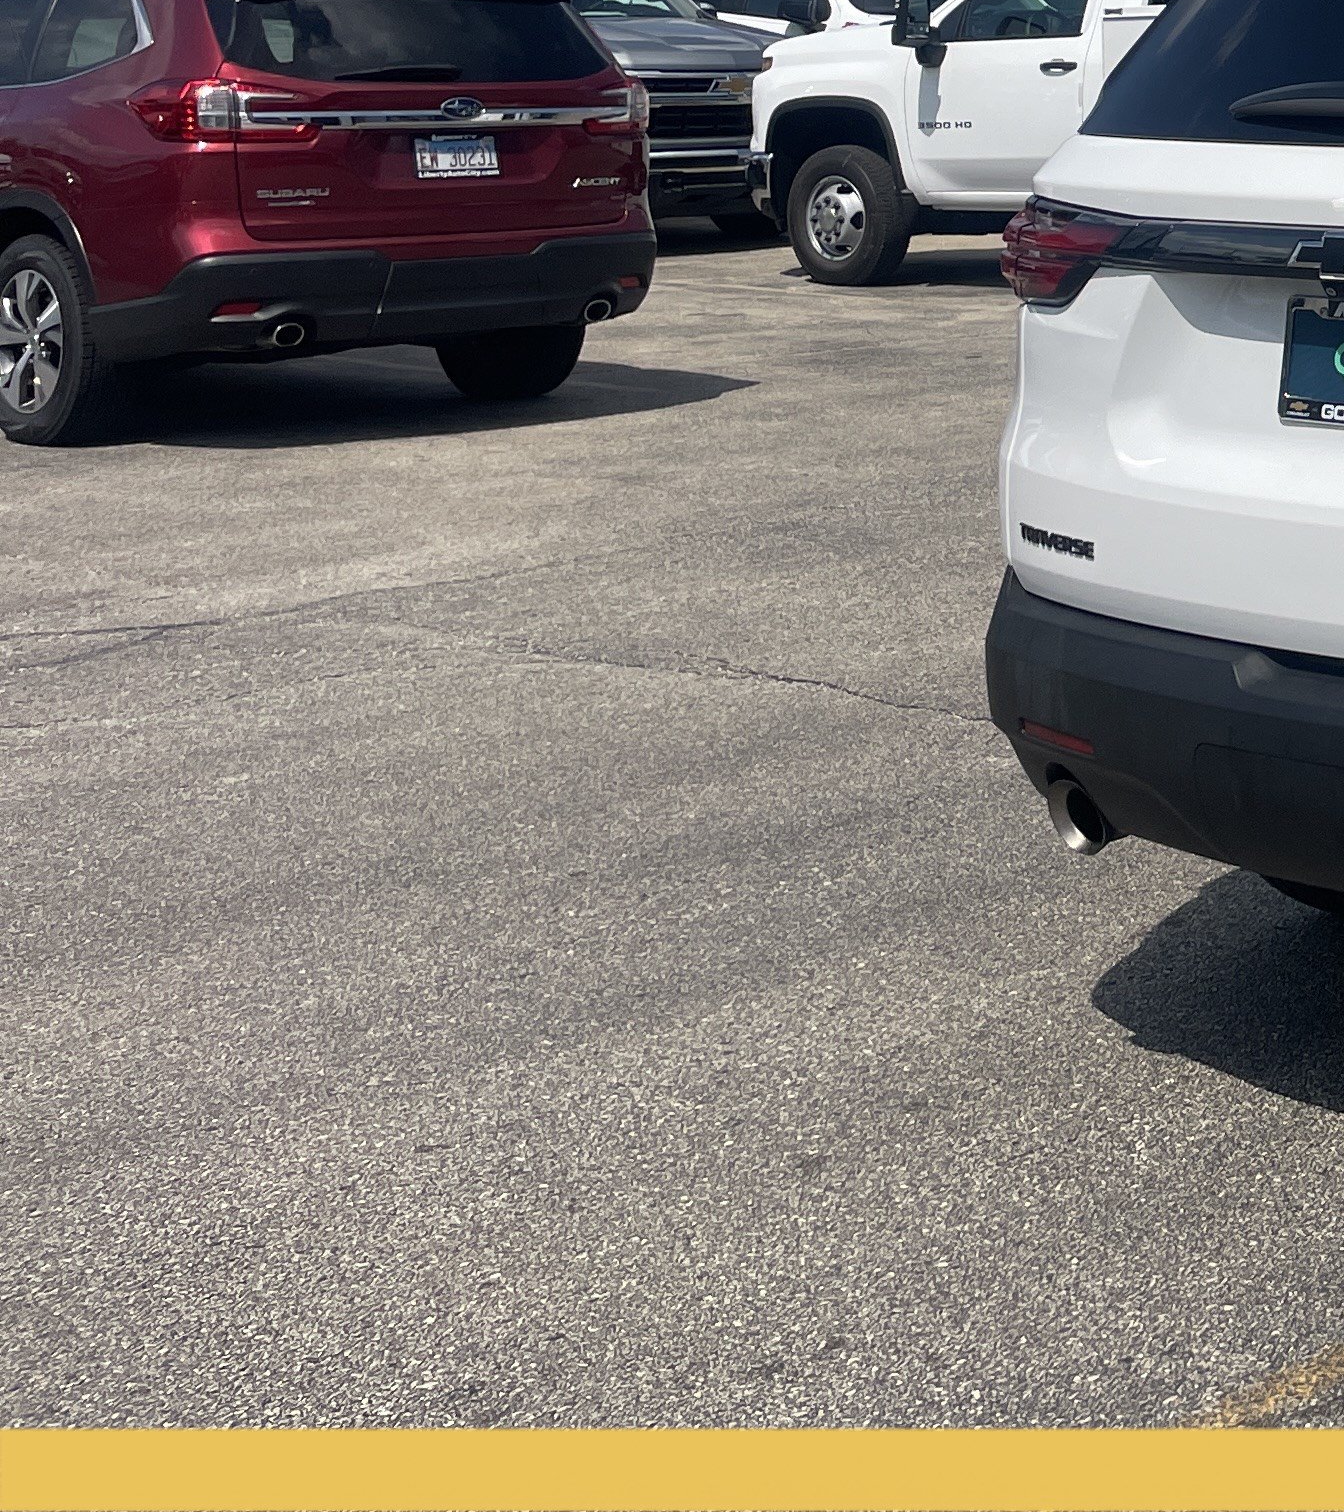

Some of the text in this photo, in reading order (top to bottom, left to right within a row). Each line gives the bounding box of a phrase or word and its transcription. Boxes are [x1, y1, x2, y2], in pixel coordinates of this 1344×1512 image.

[918, 121, 951, 129] 3500
[449, 146, 495, 168] 30231
[256, 187, 330, 199] SUBARU
